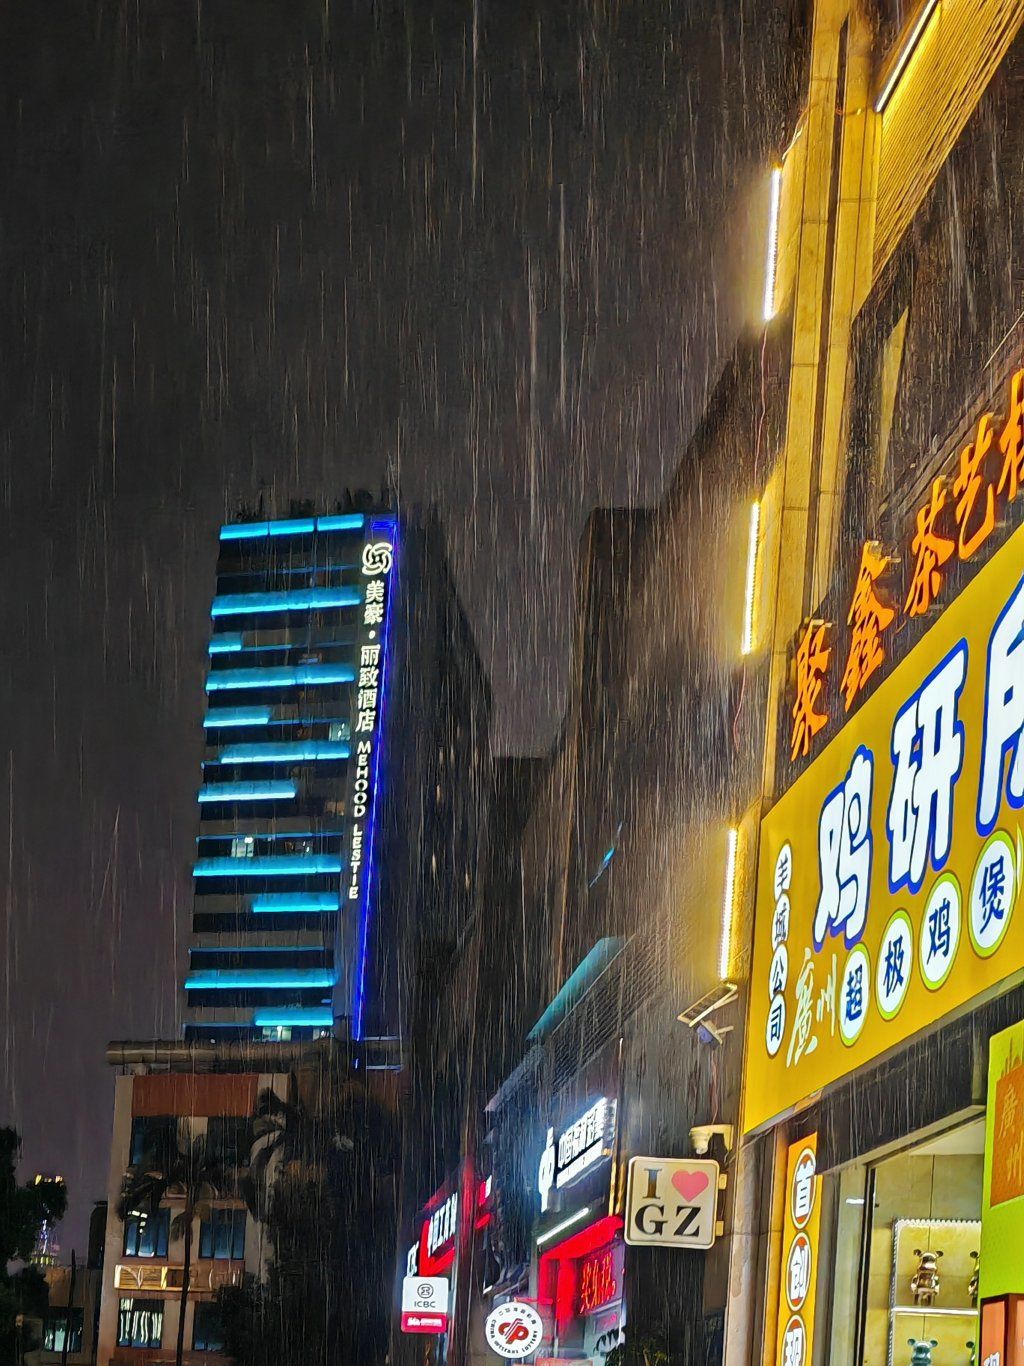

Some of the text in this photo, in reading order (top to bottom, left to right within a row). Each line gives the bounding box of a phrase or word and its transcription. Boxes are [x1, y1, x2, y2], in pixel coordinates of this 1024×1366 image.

[348, 740, 372, 900] MEHOOD LESTIE
[843, 853, 1006, 1025] 超极鸡煲
[643, 1167, 663, 1200] I
[634, 1203, 702, 1238] GZ
[413, 1300, 436, 1309] ICBC
